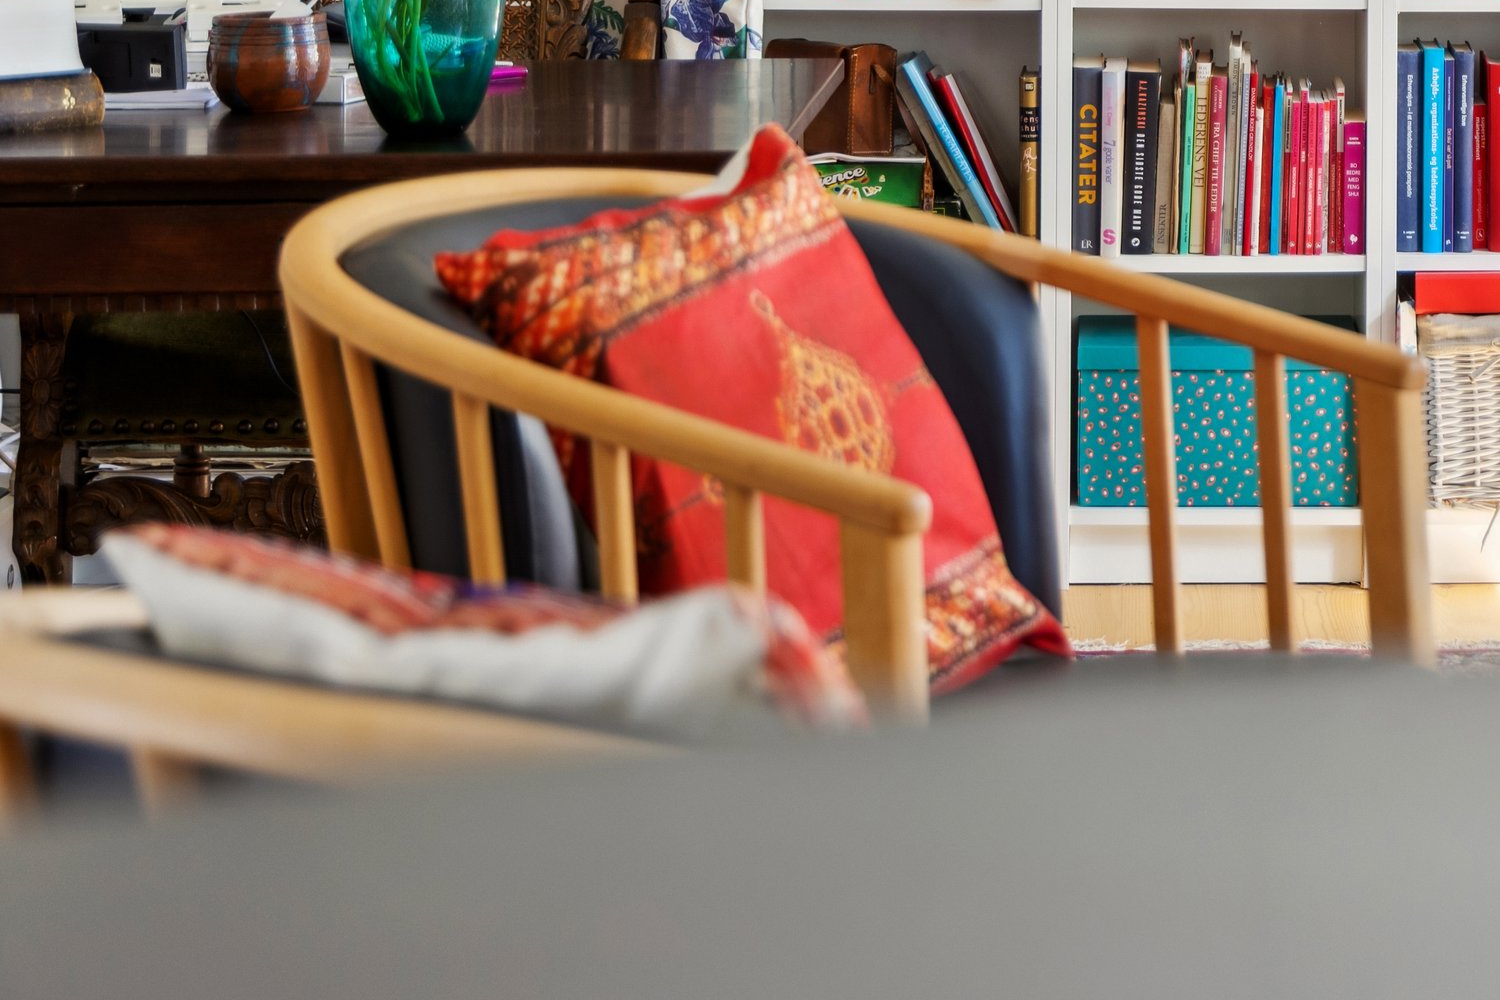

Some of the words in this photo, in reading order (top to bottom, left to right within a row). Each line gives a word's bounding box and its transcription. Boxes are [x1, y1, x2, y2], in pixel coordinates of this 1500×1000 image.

[1079, 104, 1096, 204] CITATER
[1196, 97, 1207, 162] LEDERENS
[1429, 103, 1438, 154] organisations-
[1193, 169, 1205, 188] VEJ
[1430, 156, 1437, 165] og
[1429, 168, 1438, 230] ledelsespsykologi
